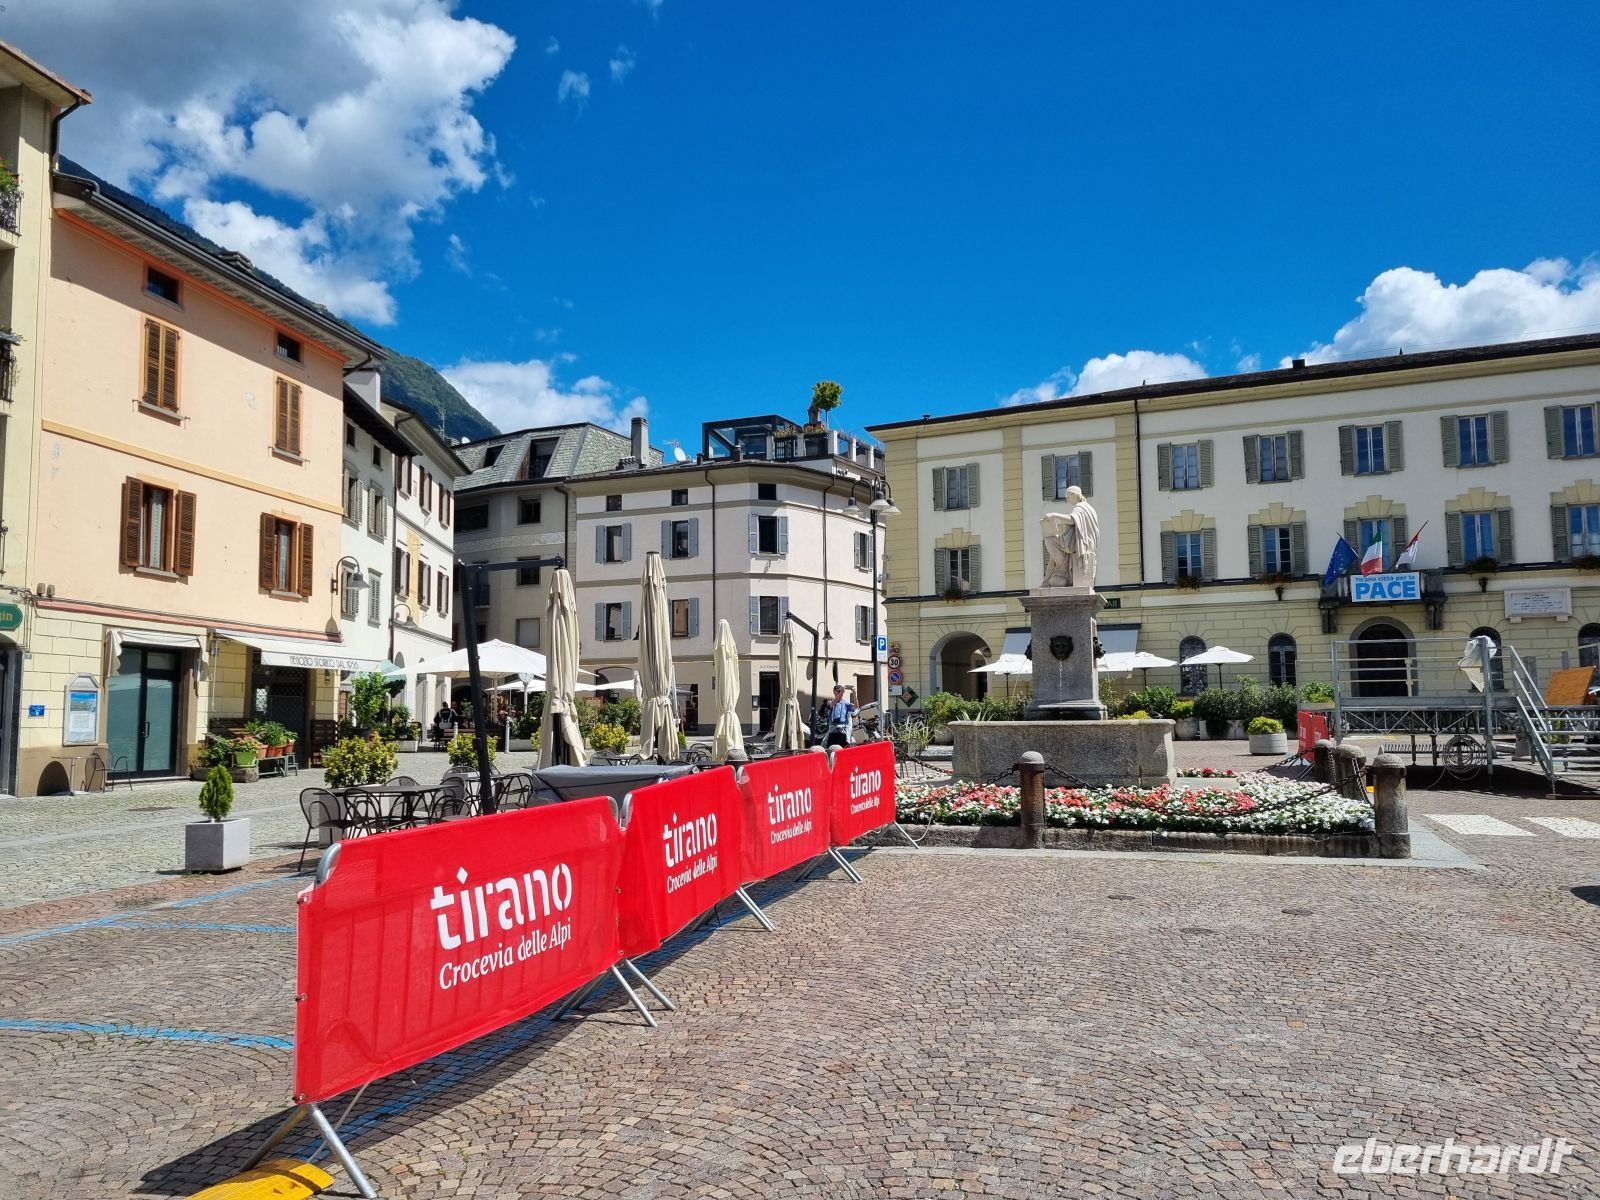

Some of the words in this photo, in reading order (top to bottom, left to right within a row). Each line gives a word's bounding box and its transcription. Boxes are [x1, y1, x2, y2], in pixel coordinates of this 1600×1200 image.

[1355, 581, 1416, 600] PACE
[290, 656, 313, 666] NEGOZIO
[314, 658, 335, 668] STORICO
[336, 660, 345, 669] DAL
[850, 766, 881, 799] tirano
[768, 784, 812, 825] tirano
[663, 812, 717, 867] tirano
[770, 825, 793, 844] Crocevia
[793, 821, 804, 837] delle
[804, 818, 812, 834] Alpi
[667, 865, 692, 894] Crocevia
[693, 858, 706, 879] delle
[706, 851, 718, 874] Alpi
[430, 863, 573, 950] tirano
[439, 942, 514, 990] Crocevia
[517, 929, 548, 962] delle
[548, 917, 572, 950] Alpi
